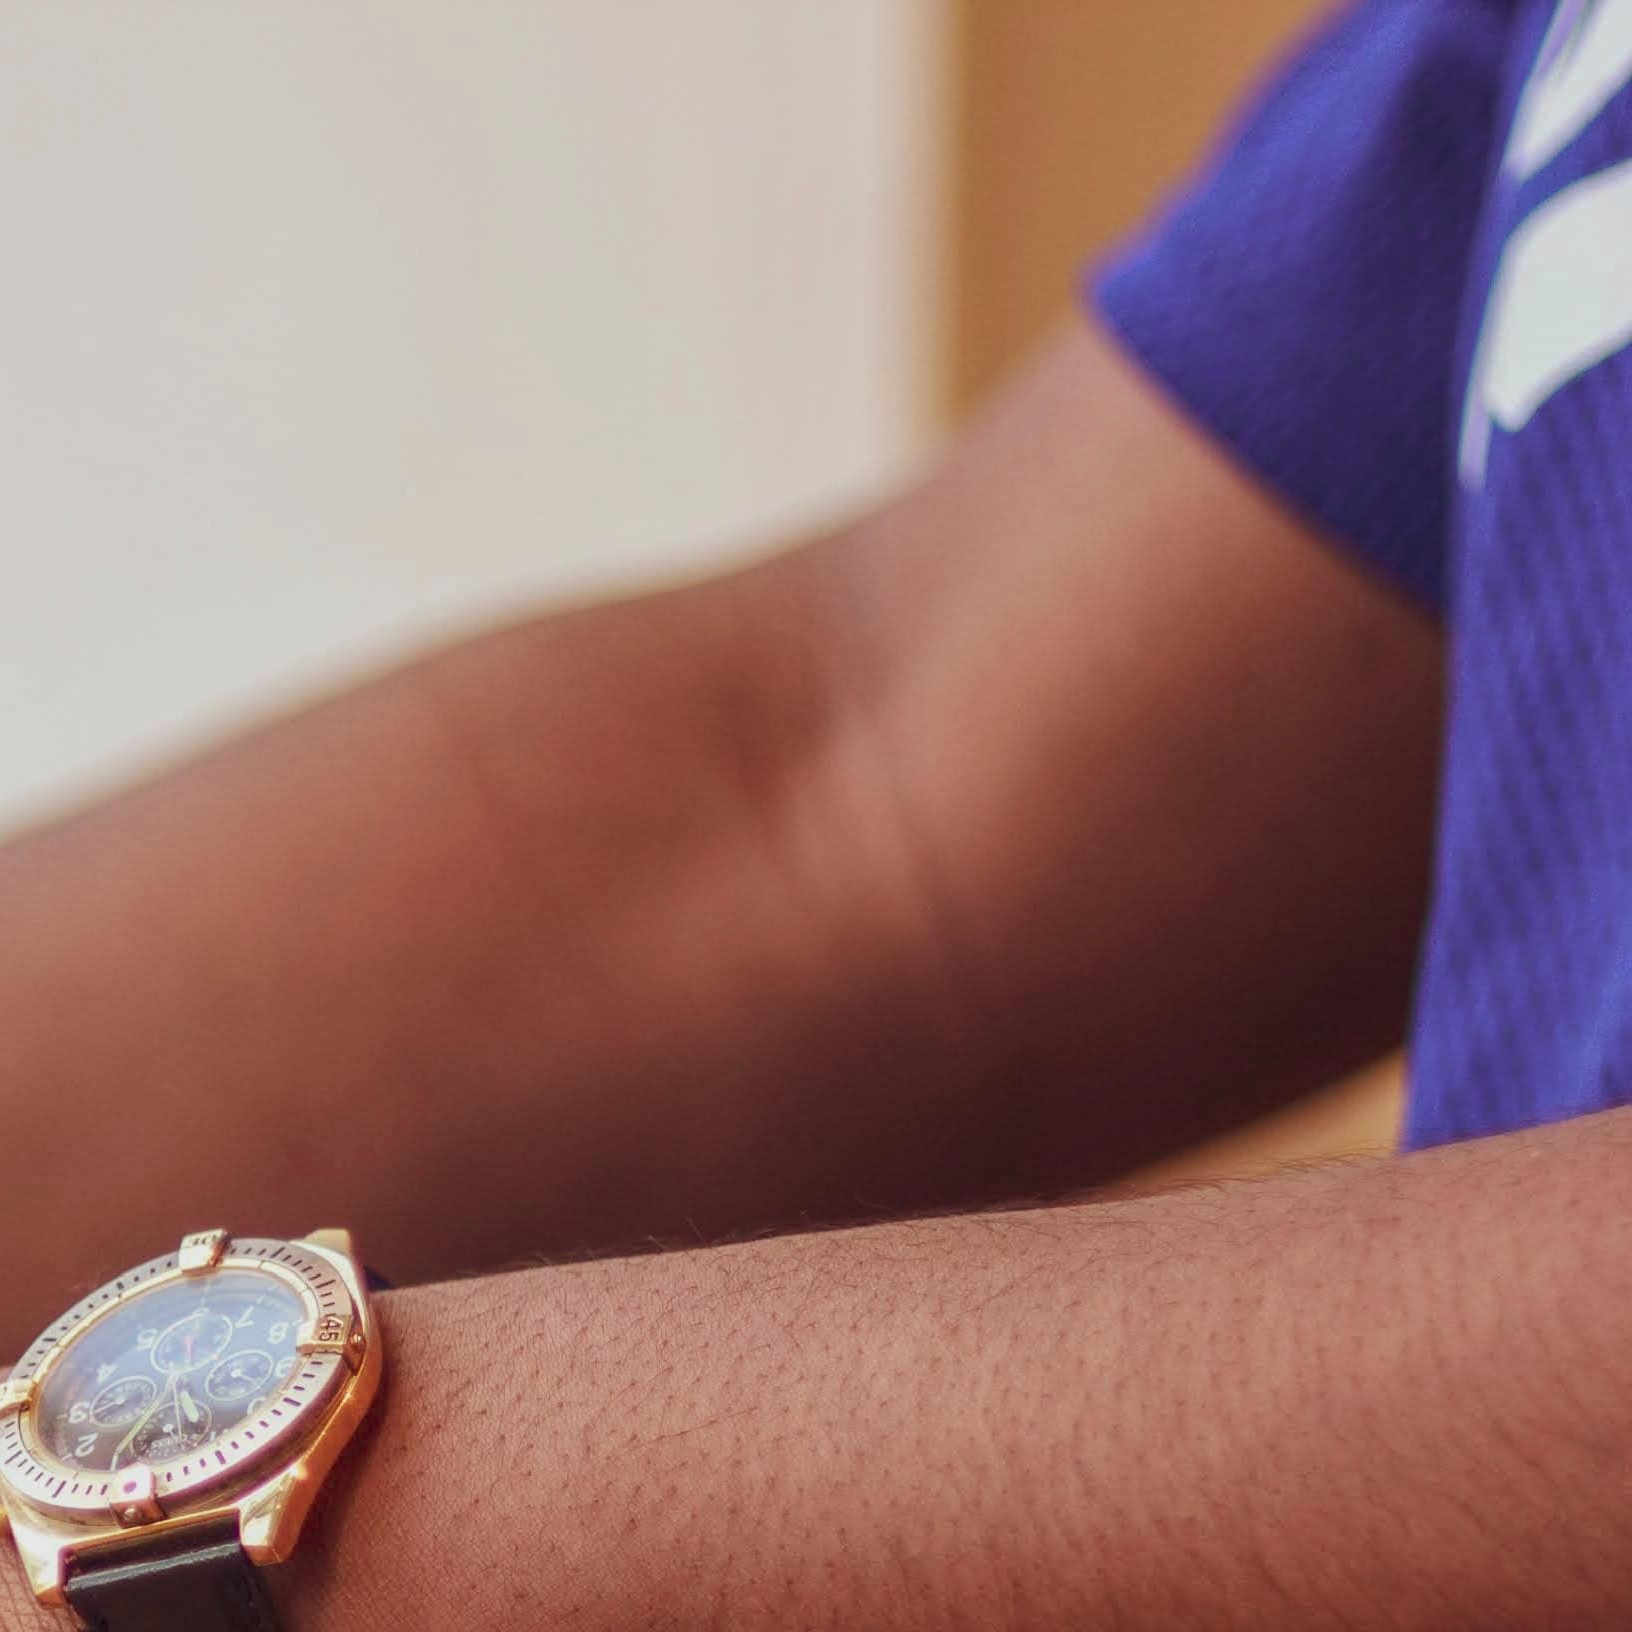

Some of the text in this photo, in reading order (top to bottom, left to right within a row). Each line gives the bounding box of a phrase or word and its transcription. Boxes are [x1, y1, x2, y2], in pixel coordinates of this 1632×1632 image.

[320, 1316, 344, 1342] 45
[69, 1401, 90, 1424] 3
[75, 1432, 99, 1457] 2
